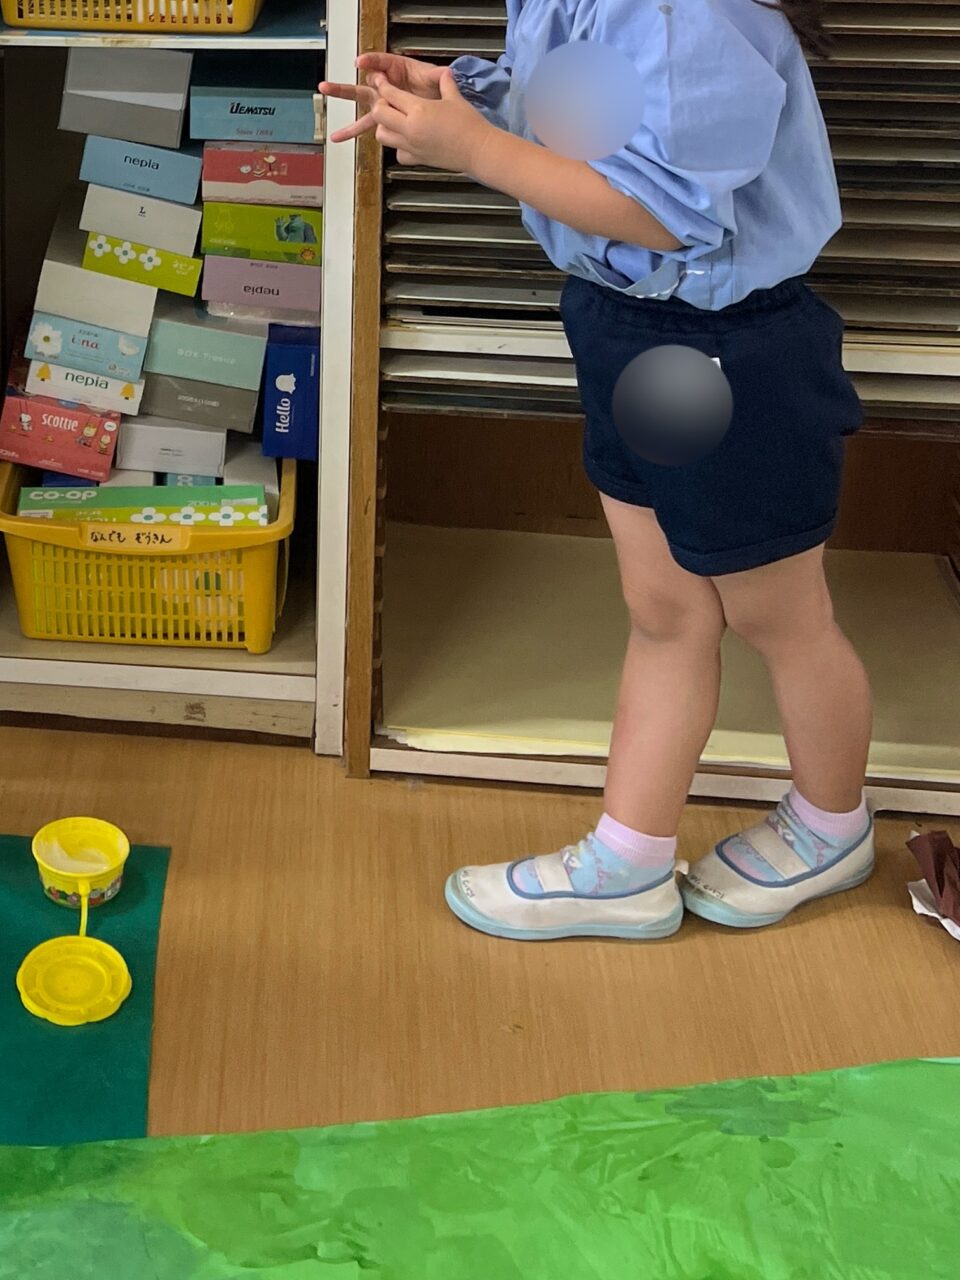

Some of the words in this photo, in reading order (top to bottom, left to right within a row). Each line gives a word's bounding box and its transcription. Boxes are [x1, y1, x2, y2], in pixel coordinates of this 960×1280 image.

[229, 102, 276, 116] UEMATSU
[123, 154, 160, 170] nepia
[243, 284, 280, 296] nepia
[64, 371, 110, 390] nepia
[275, 398, 291, 434] Hello
[90, 531, 126, 543] なんでも
[135, 532, 172, 545] ぞうきん
